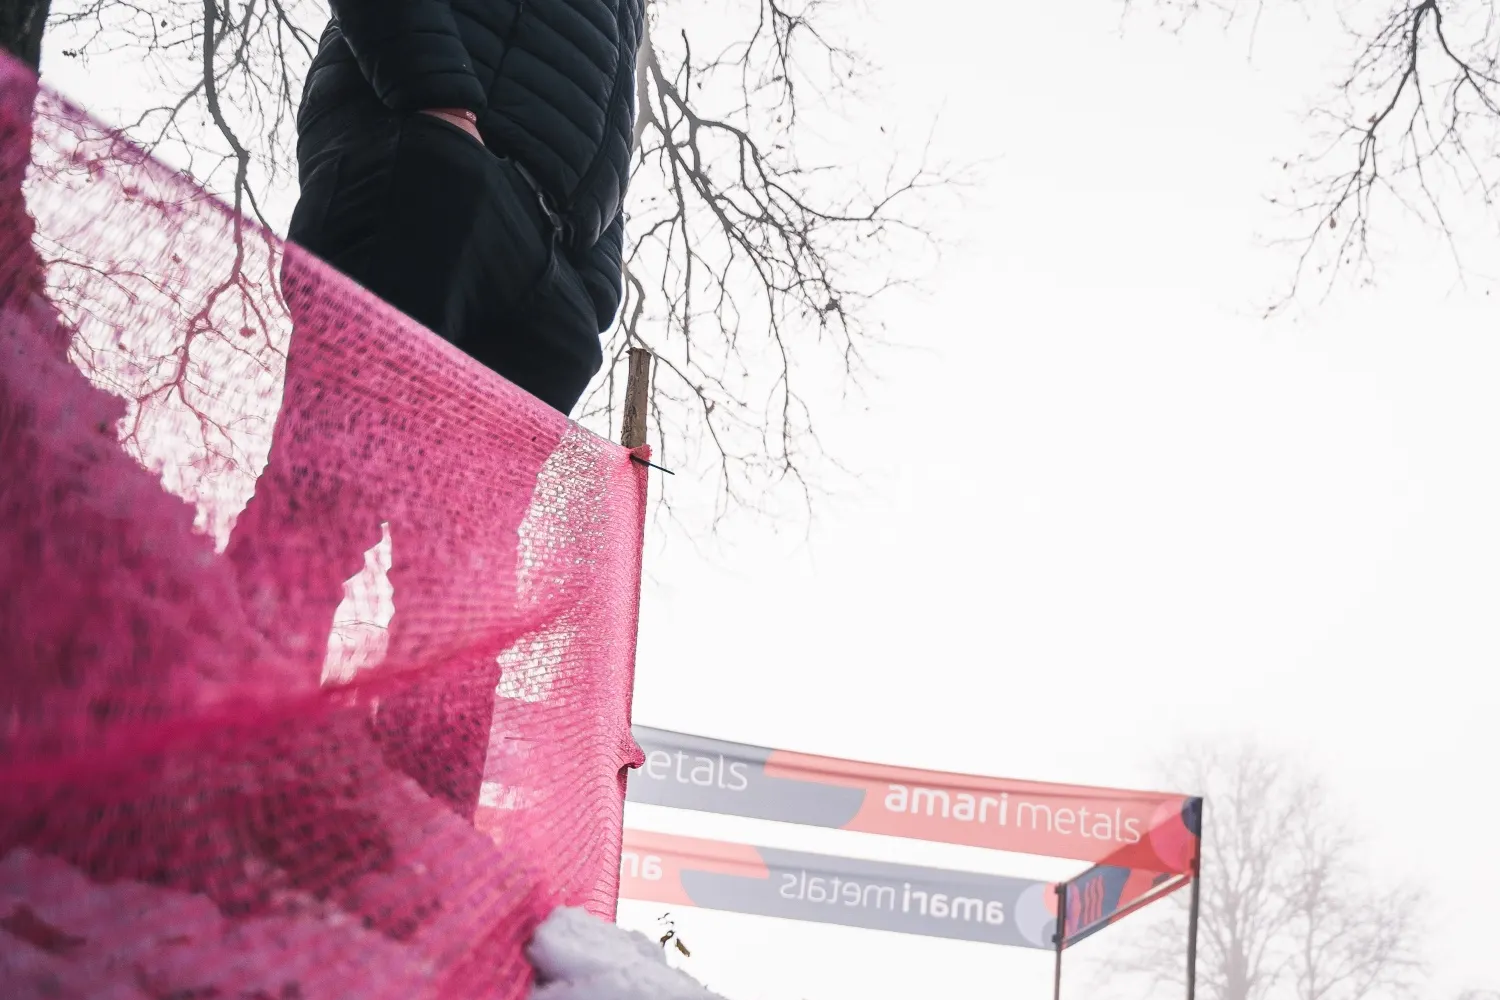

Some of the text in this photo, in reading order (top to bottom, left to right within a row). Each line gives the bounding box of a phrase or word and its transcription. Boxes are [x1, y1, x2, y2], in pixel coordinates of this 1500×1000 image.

[633, 750, 749, 791] etals
[884, 783, 1142, 843] amari metals
